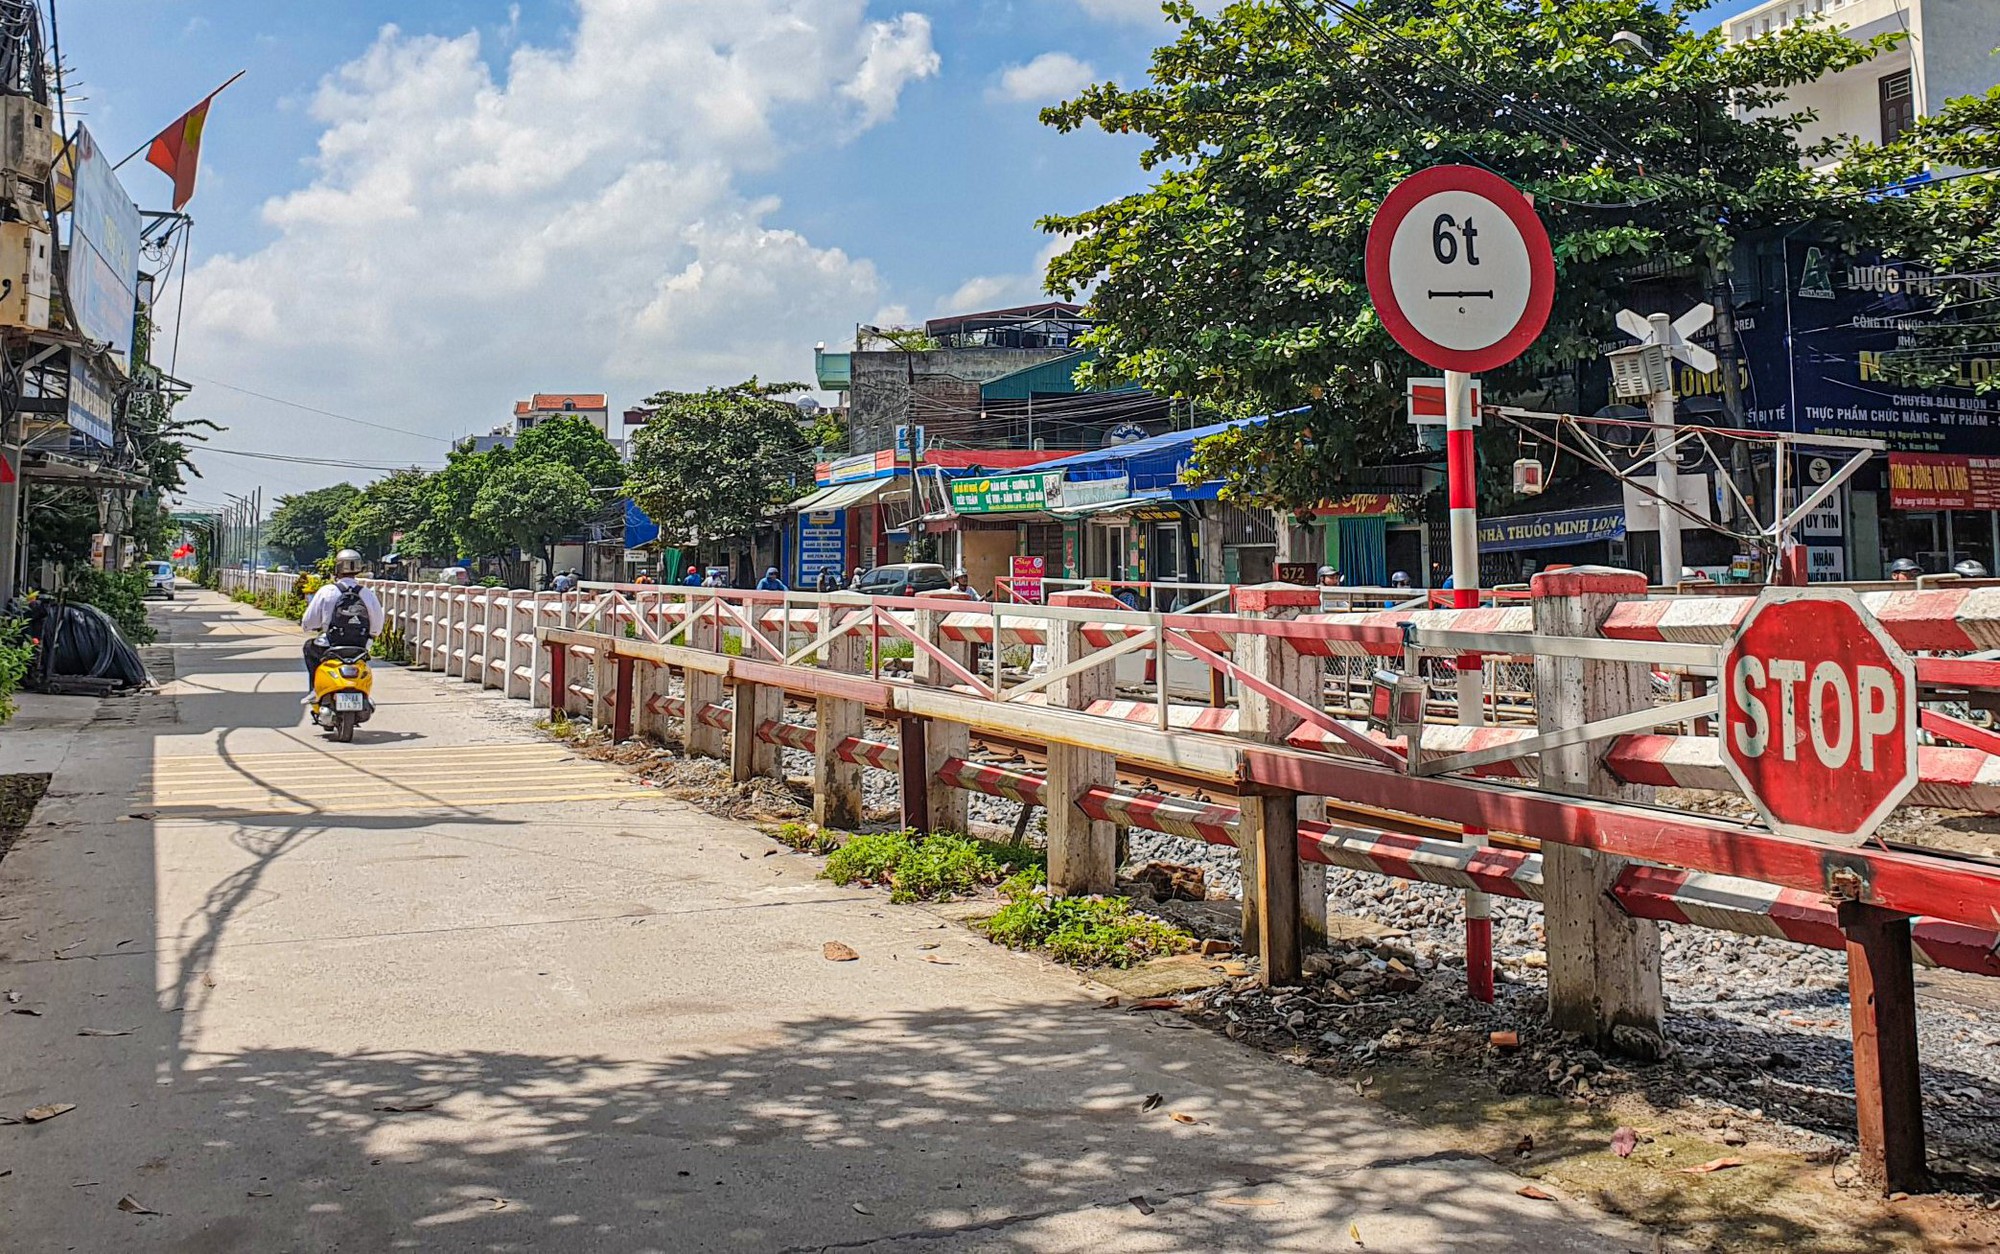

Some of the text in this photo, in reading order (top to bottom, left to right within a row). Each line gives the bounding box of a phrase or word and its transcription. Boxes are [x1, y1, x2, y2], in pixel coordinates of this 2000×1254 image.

[1433, 214, 1479, 266] 6t
[1805, 406, 1834, 422] THỰC
[1837, 404, 1868, 422] PHẨM
[1871, 407, 1899, 422] CHỨC
[1902, 410, 1930, 424] NĂNG
[1959, 411, 1988, 427] PHẨM
[1479, 524, 1505, 543] NHÀ
[1507, 517, 1551, 540] THUỐC
[1554, 519, 1589, 536] MINH
[1806, 513, 1839, 529] UY TÍN
[1813, 547, 1834, 569] NHẬN
[1281, 566, 1305, 580] 372
[1733, 655, 1897, 772] STOP
